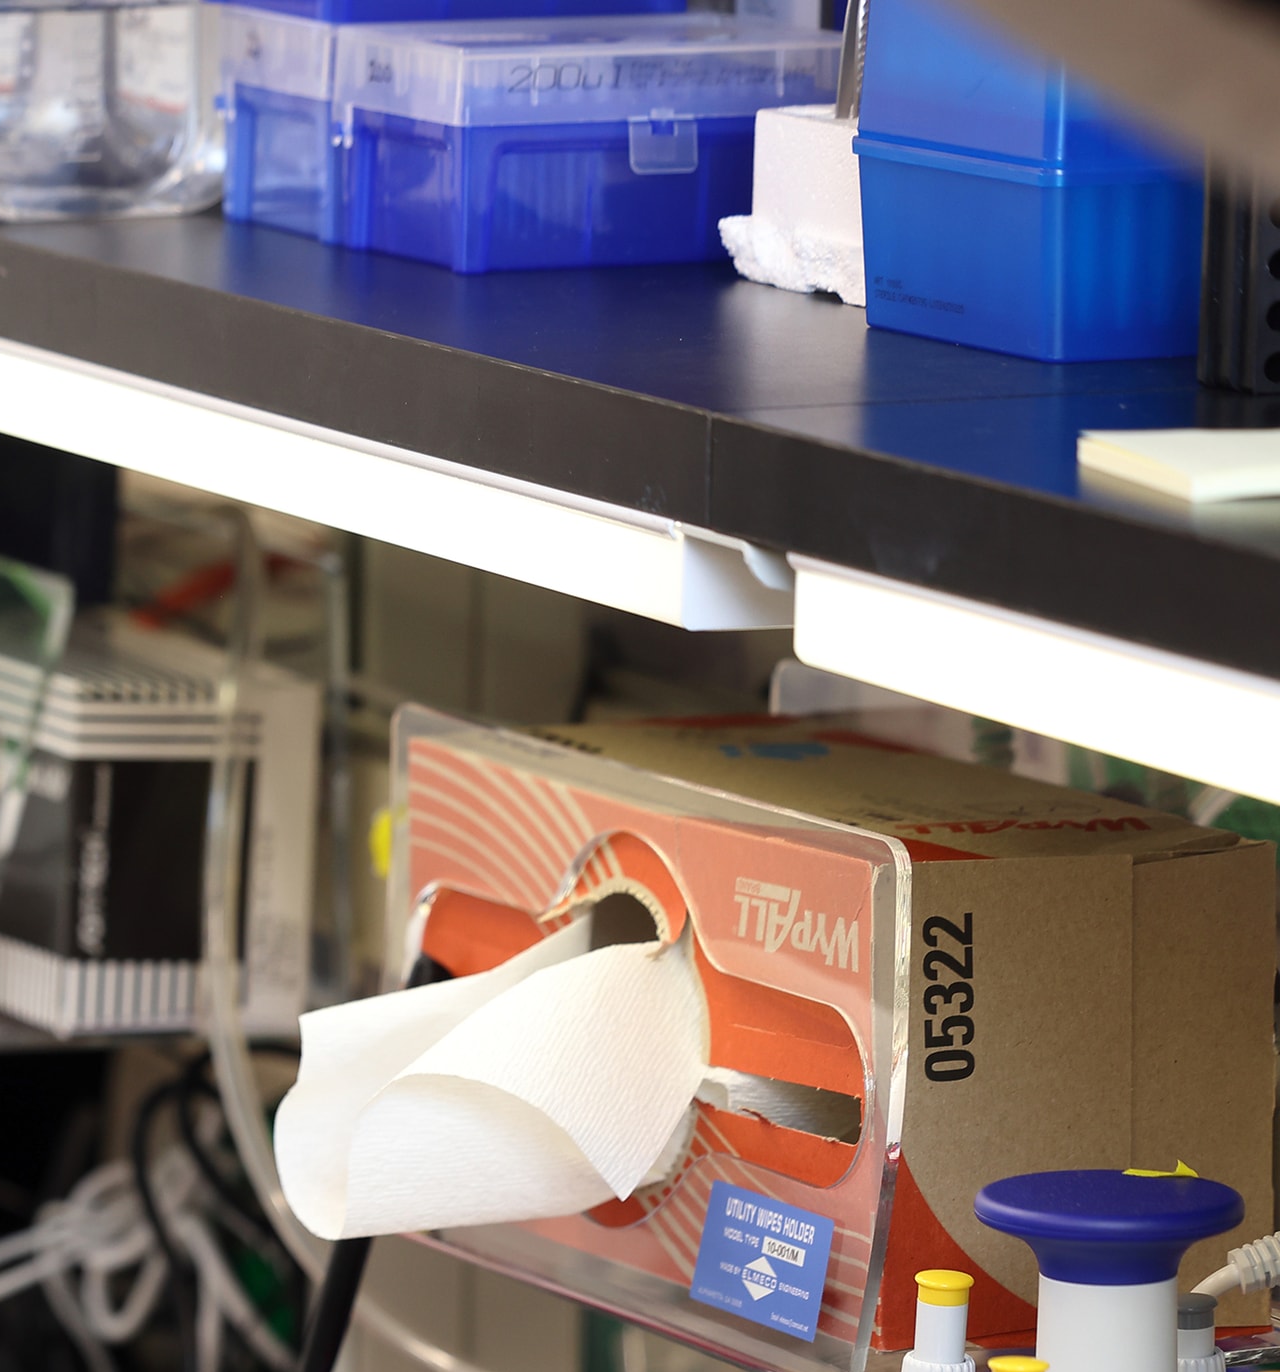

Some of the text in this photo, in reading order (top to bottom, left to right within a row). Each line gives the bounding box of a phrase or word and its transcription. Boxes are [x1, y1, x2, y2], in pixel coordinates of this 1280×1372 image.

[922, 912, 976, 1082] 05322
[723, 1226, 744, 1243] MODEL
[744, 1233, 760, 1248] TYPE
[725, 1196, 816, 1245] UTILITY WIPES HOLDER
[741, 1268, 778, 1289] ELMECO
